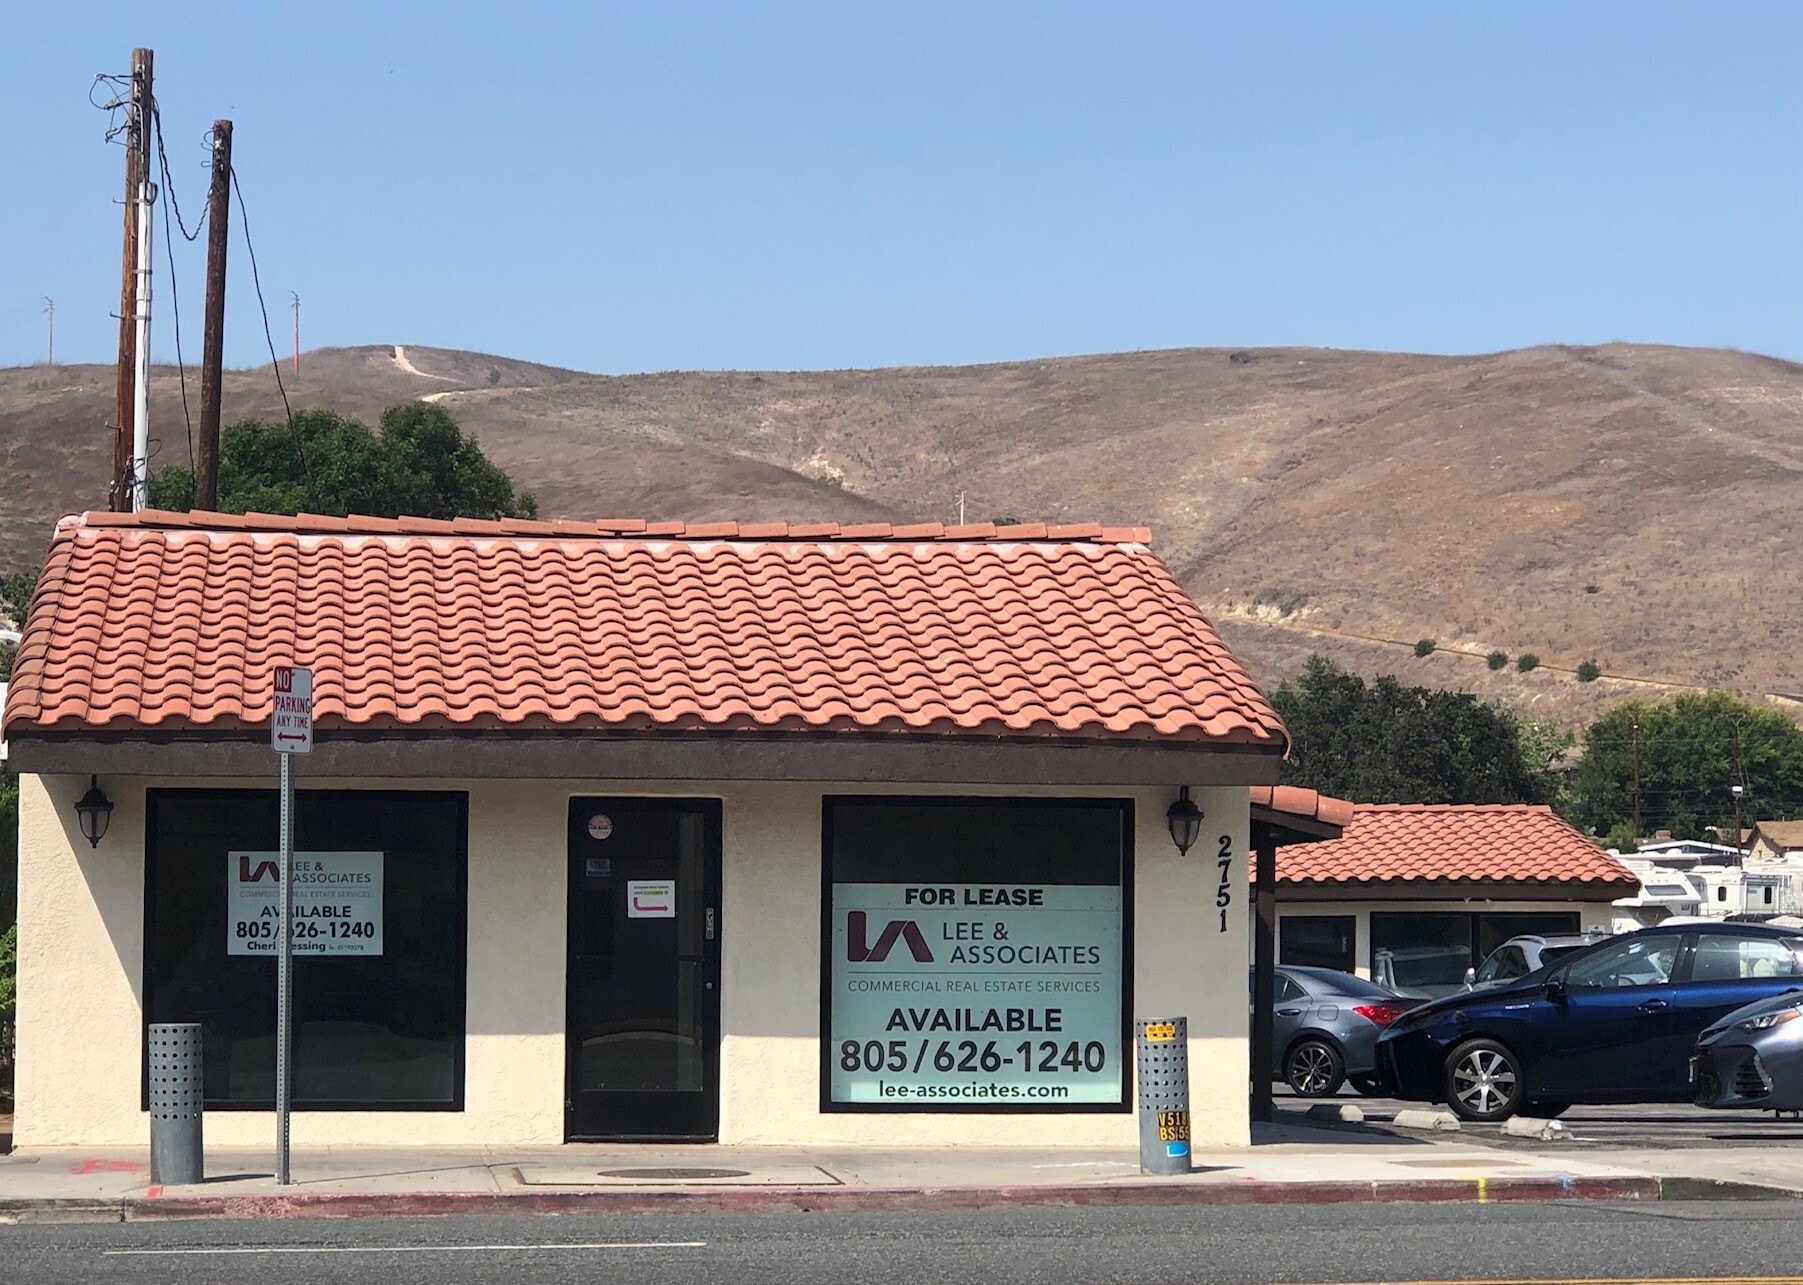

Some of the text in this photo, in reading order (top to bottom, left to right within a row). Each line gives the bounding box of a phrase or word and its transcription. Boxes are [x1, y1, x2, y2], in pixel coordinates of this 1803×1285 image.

[275, 670, 290, 690] NO
[275, 695, 311, 714] PARKING
[276, 715, 308, 729] ANY TIME
[292, 861, 324, 872] EE &
[292, 873, 371, 884] ASSOCIATES
[1217, 835, 1231, 933] 2751
[240, 890, 280, 898] COMMERCI
[310, 890, 335, 898] ESTATE
[337, 890, 371, 898] SERVICES
[905, 888, 1043, 906] FOR LEASE
[260, 905, 352, 918] AVILABLE
[236, 921, 375, 939] 805/26-1240
[943, 922, 1009, 940] LEE &
[247, 941, 276, 951] Cheri
[950, 946, 1100, 964] ASSOCIATES
[848, 980, 1100, 993] COMMERCIAL REAL ESTATE SERVICES
[885, 1008, 1063, 1032] AVAILABLE
[840, 1039, 1105, 1073] 805/626-1240
[879, 1080, 1069, 1098] lee-associates.com
